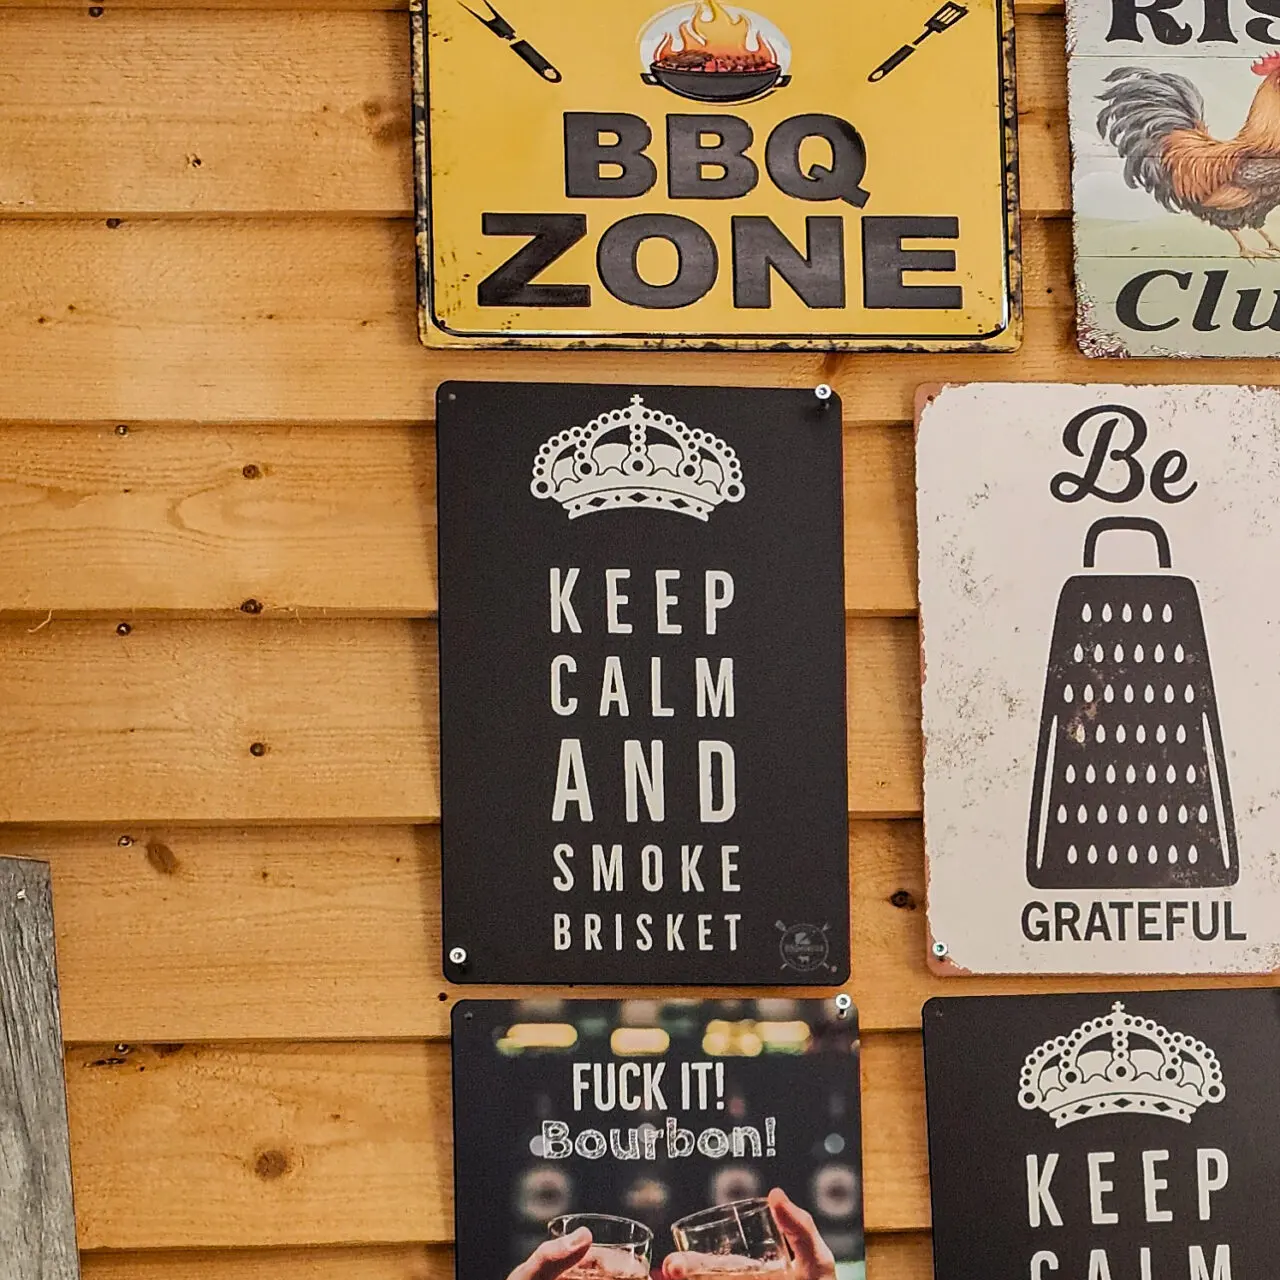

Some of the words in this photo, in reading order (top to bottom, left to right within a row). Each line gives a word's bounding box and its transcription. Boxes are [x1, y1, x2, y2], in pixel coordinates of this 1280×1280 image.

[563, 111, 871, 208] BBQ
[477, 212, 964, 310] ZONE
[1049, 404, 1198, 504] Be
[549, 567, 735, 635] KEEP
[550, 654, 736, 718] CALM
[551, 738, 737, 823] AND
[552, 843, 742, 893] SMOKE
[553, 912, 742, 952] BRISKET
[1020, 900, 1248, 943] GRATEFUL
[573, 1062, 668, 1111] FUCK
[681, 1062, 725, 1110] IT!
[542, 1117, 777, 1160] Bourbon!
[1025, 1147, 1229, 1228] KEEP
